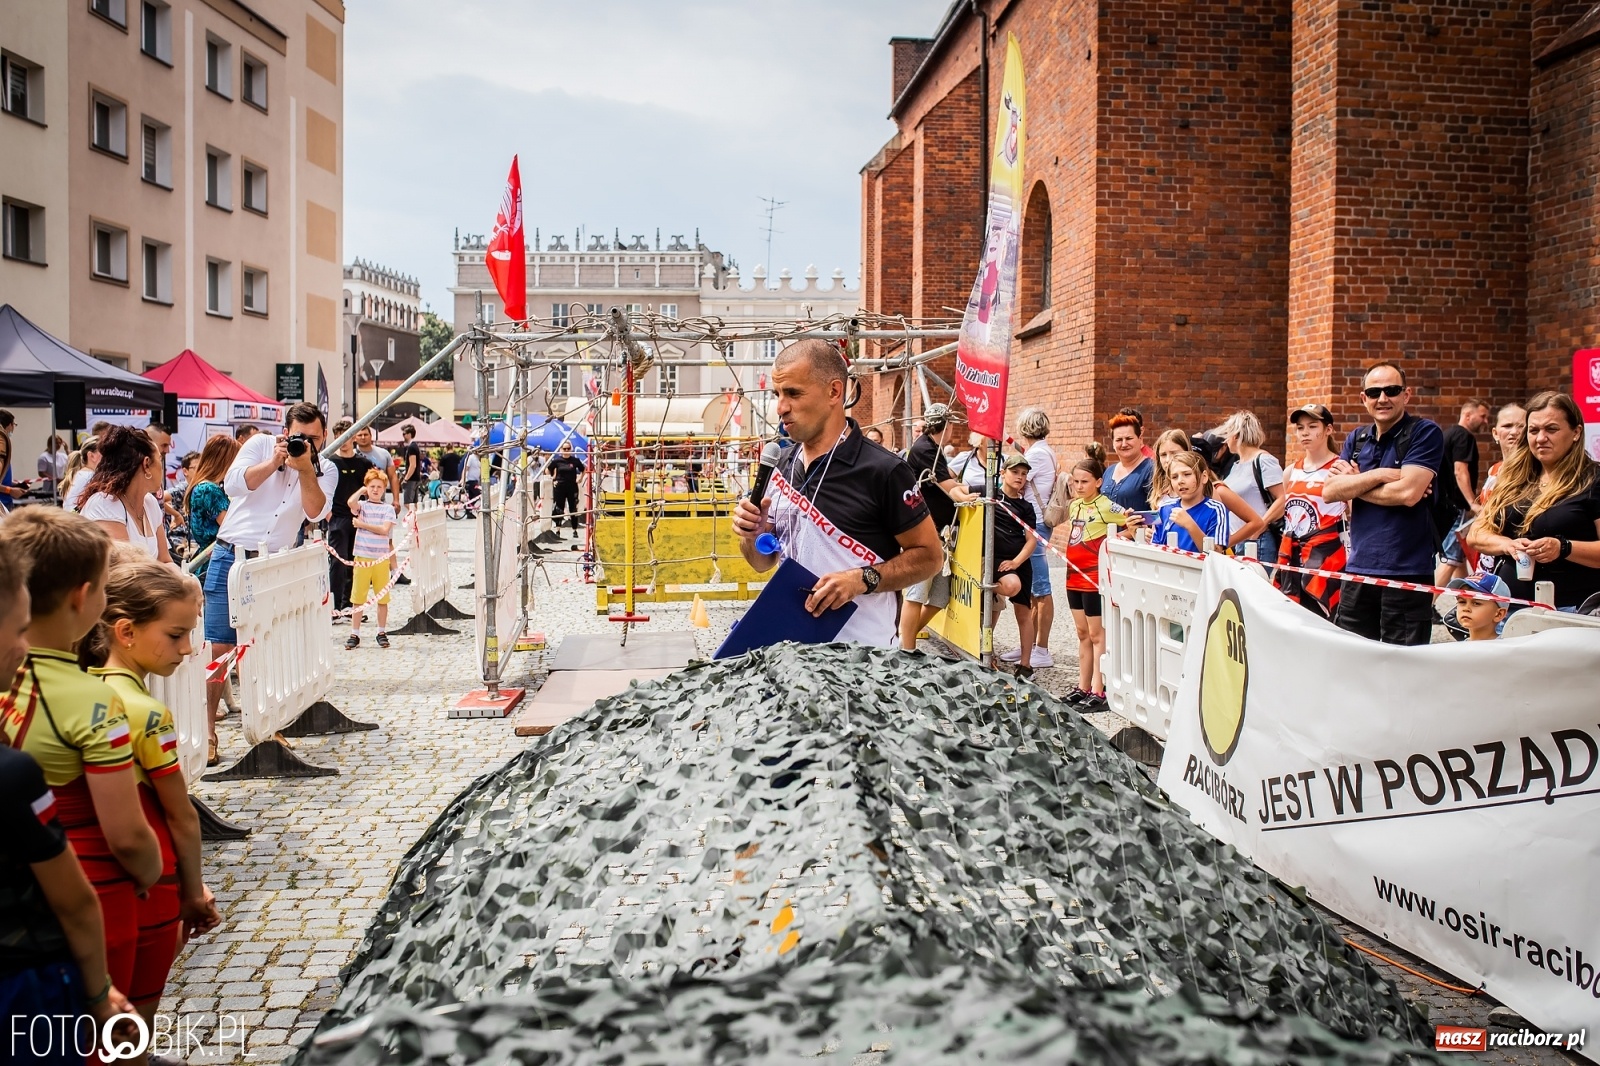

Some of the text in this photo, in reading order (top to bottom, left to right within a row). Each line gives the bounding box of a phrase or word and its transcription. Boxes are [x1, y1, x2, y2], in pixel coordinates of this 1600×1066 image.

[91, 387, 134, 399] www.raciborz.pl
[837, 535, 878, 565] OCR
[1183, 754, 1247, 825] RACIBÓRZ
[1258, 724, 1600, 825] JEST W PORZĄD
